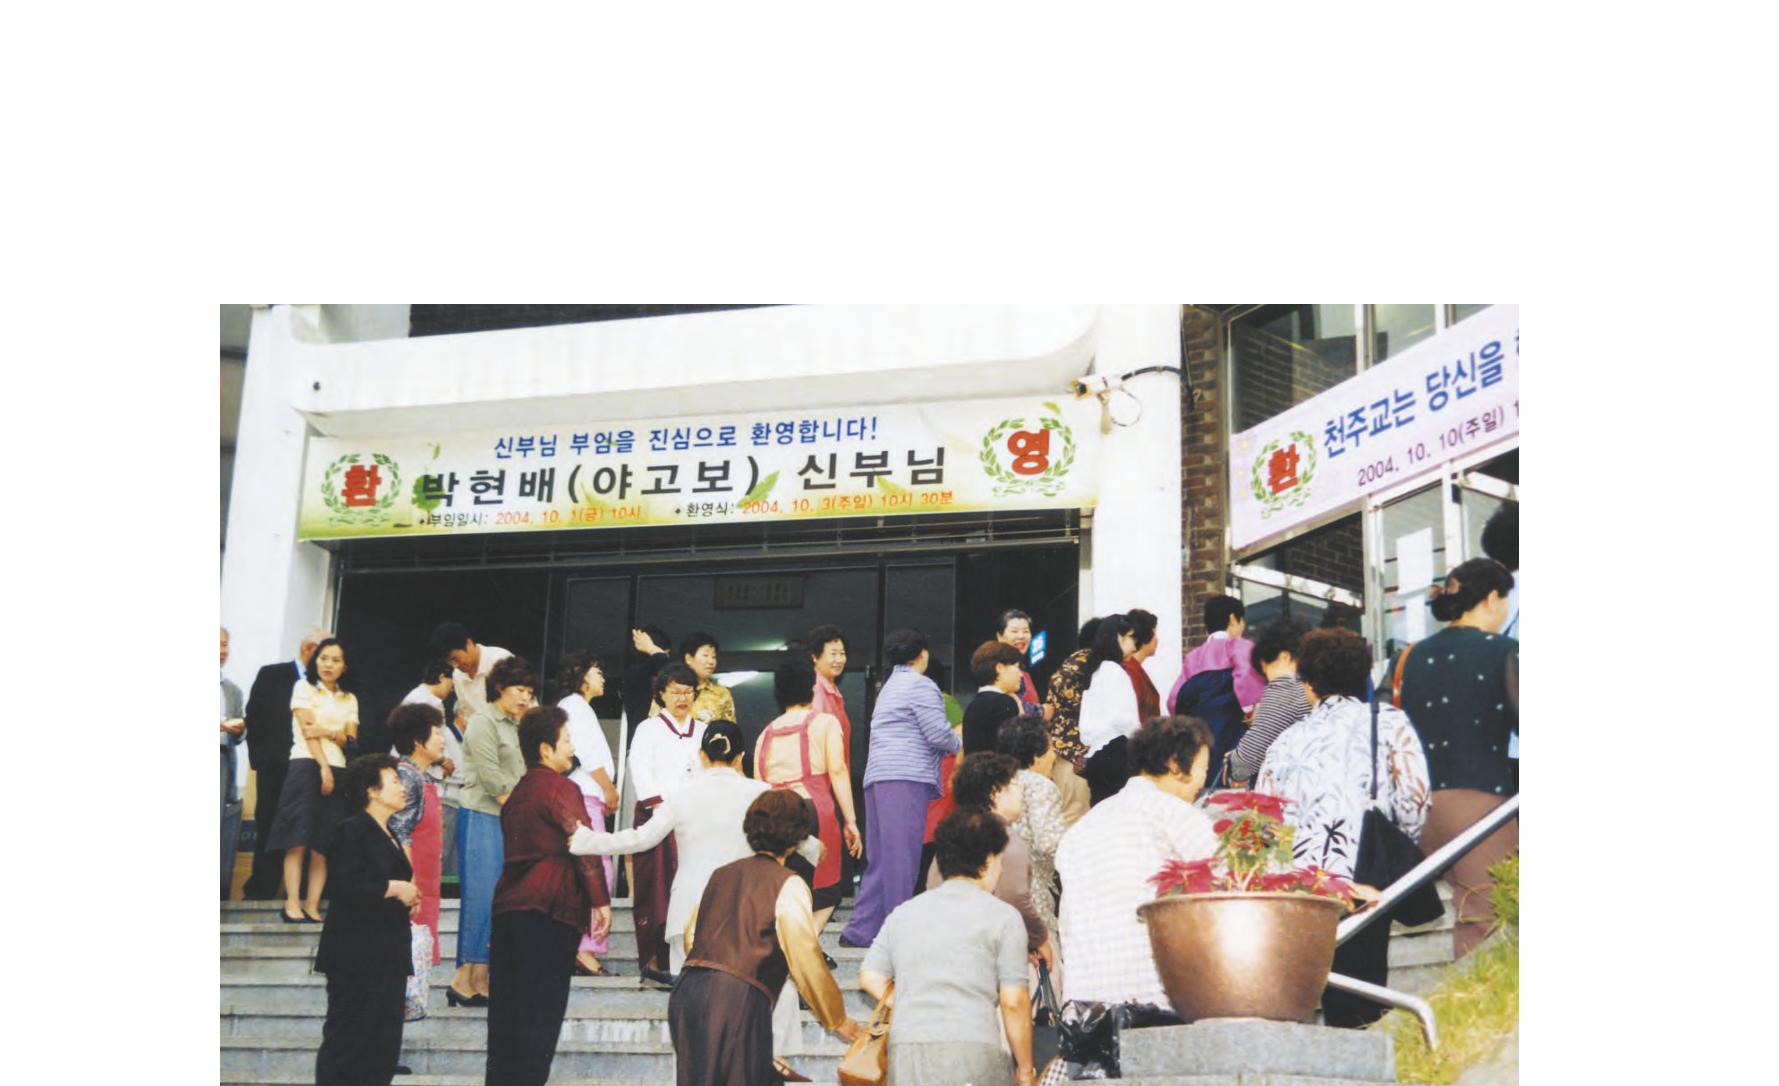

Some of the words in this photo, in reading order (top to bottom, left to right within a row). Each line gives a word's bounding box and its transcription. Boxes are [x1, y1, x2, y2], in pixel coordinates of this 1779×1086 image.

[1323, 389, 1417, 459] 천주교는
[1426, 341, 1505, 412] 당신을
[494, 433, 558, 459] 신부님
[570, 430, 636, 457] 부임을
[649, 426, 737, 451] 진심으로
[750, 417, 878, 447] 환영합니다!
[1006, 427, 1051, 477] 영
[1358, 455, 1400, 488] 2004.
[1407, 442, 1431, 465] 10.
[1440, 406, 1505, 448] 10(주일)
[341, 463, 383, 508] 환
[797, 446, 946, 491] 신부님
[1267, 442, 1300, 496] 환
[495, 510, 534, 525] 2004.
[610, 505, 642, 521] 10시
[685, 501, 735, 518] 환영식:
[742, 499, 784, 515] 2004.
[792, 498, 814, 513] 10.
[822, 495, 874, 512] 3(주일)
[881, 493, 913, 509] 10시
[921, 490, 954, 506] 30분
